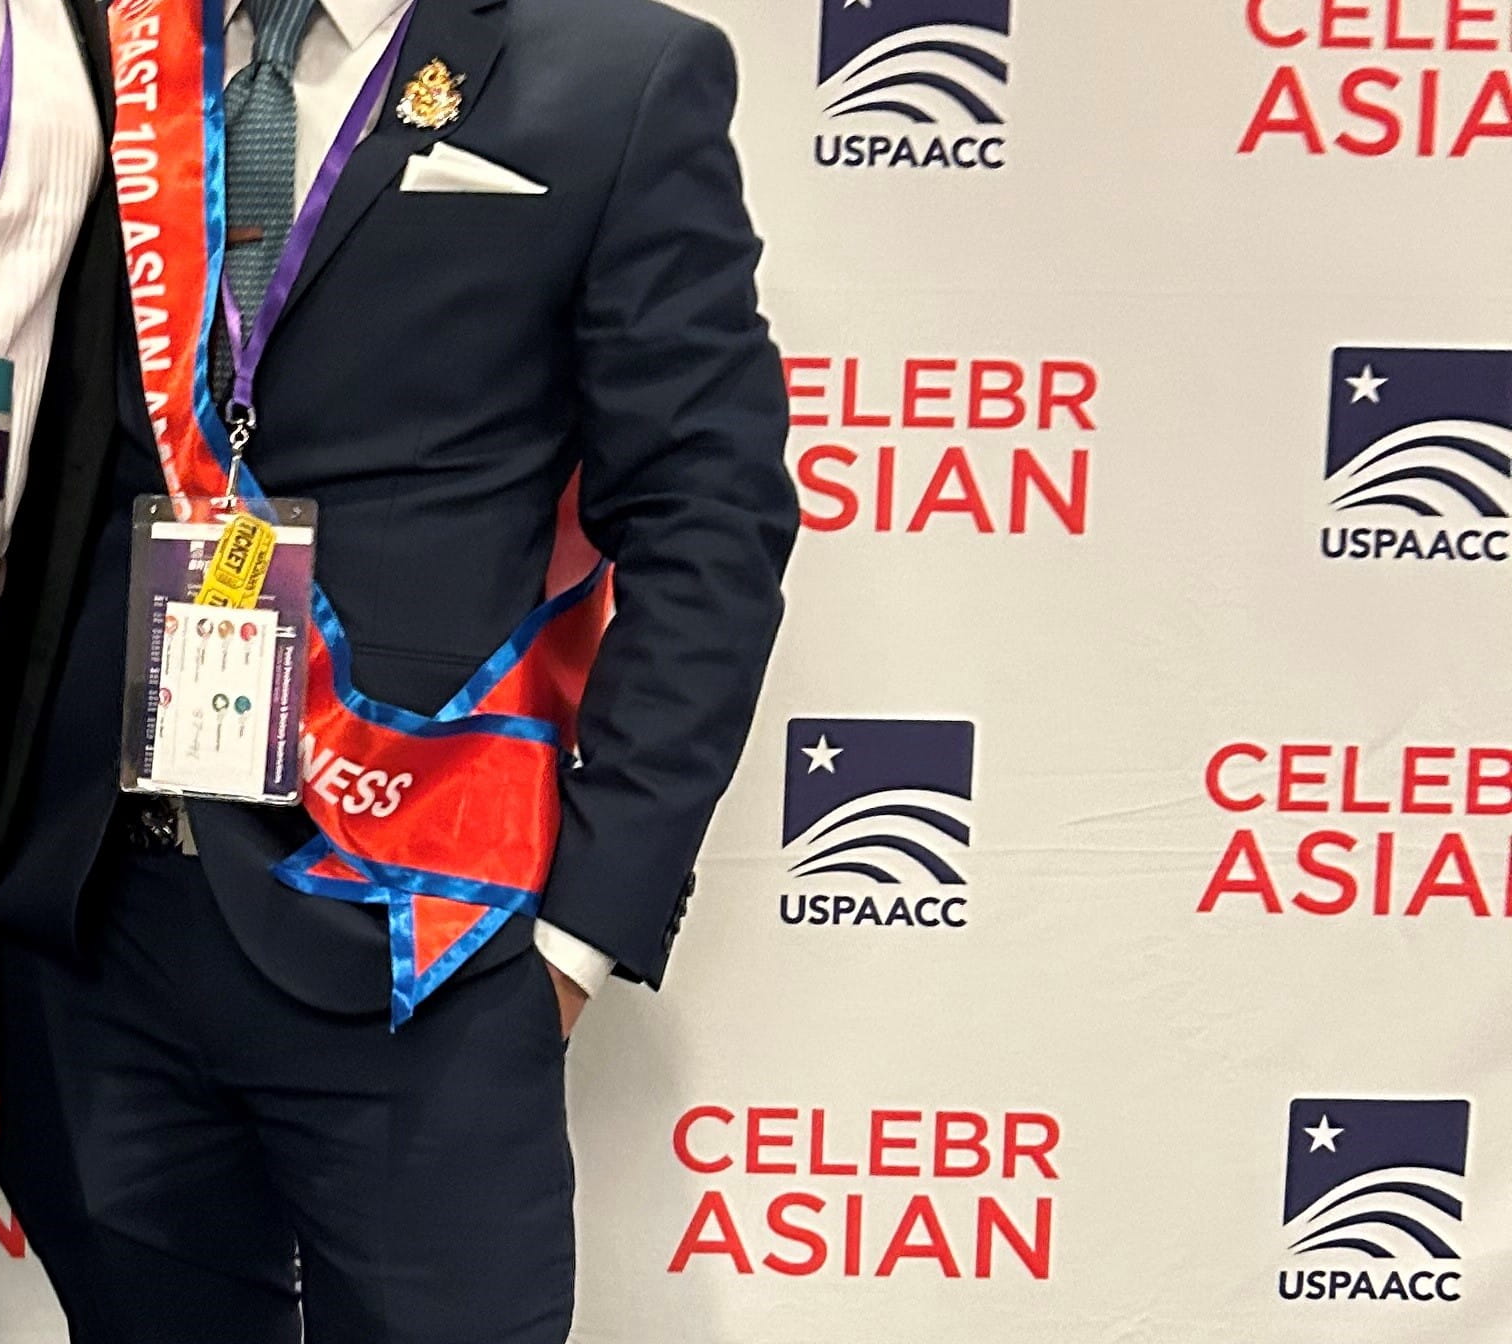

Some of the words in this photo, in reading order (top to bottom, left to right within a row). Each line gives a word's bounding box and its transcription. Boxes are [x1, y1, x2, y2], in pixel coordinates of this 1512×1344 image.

[114, 14, 160, 112] FAST
[112, 122, 159, 206] 100
[813, 134, 1006, 171] USPAACC
[781, 356, 1099, 431] ELEBR
[796, 444, 1090, 536] SIAN
[224, 521, 258, 575] TICKET
[1320, 527, 1510, 563] USPAACC
[299, 732, 414, 818] NESS
[1196, 828, 1512, 918] ASIA
[779, 893, 969, 929] USPAACC
[672, 1105, 1062, 1180] CELEBR
[667, 1190, 1054, 1281] ASIAN
[1277, 1270, 1463, 1303] USPAACC
